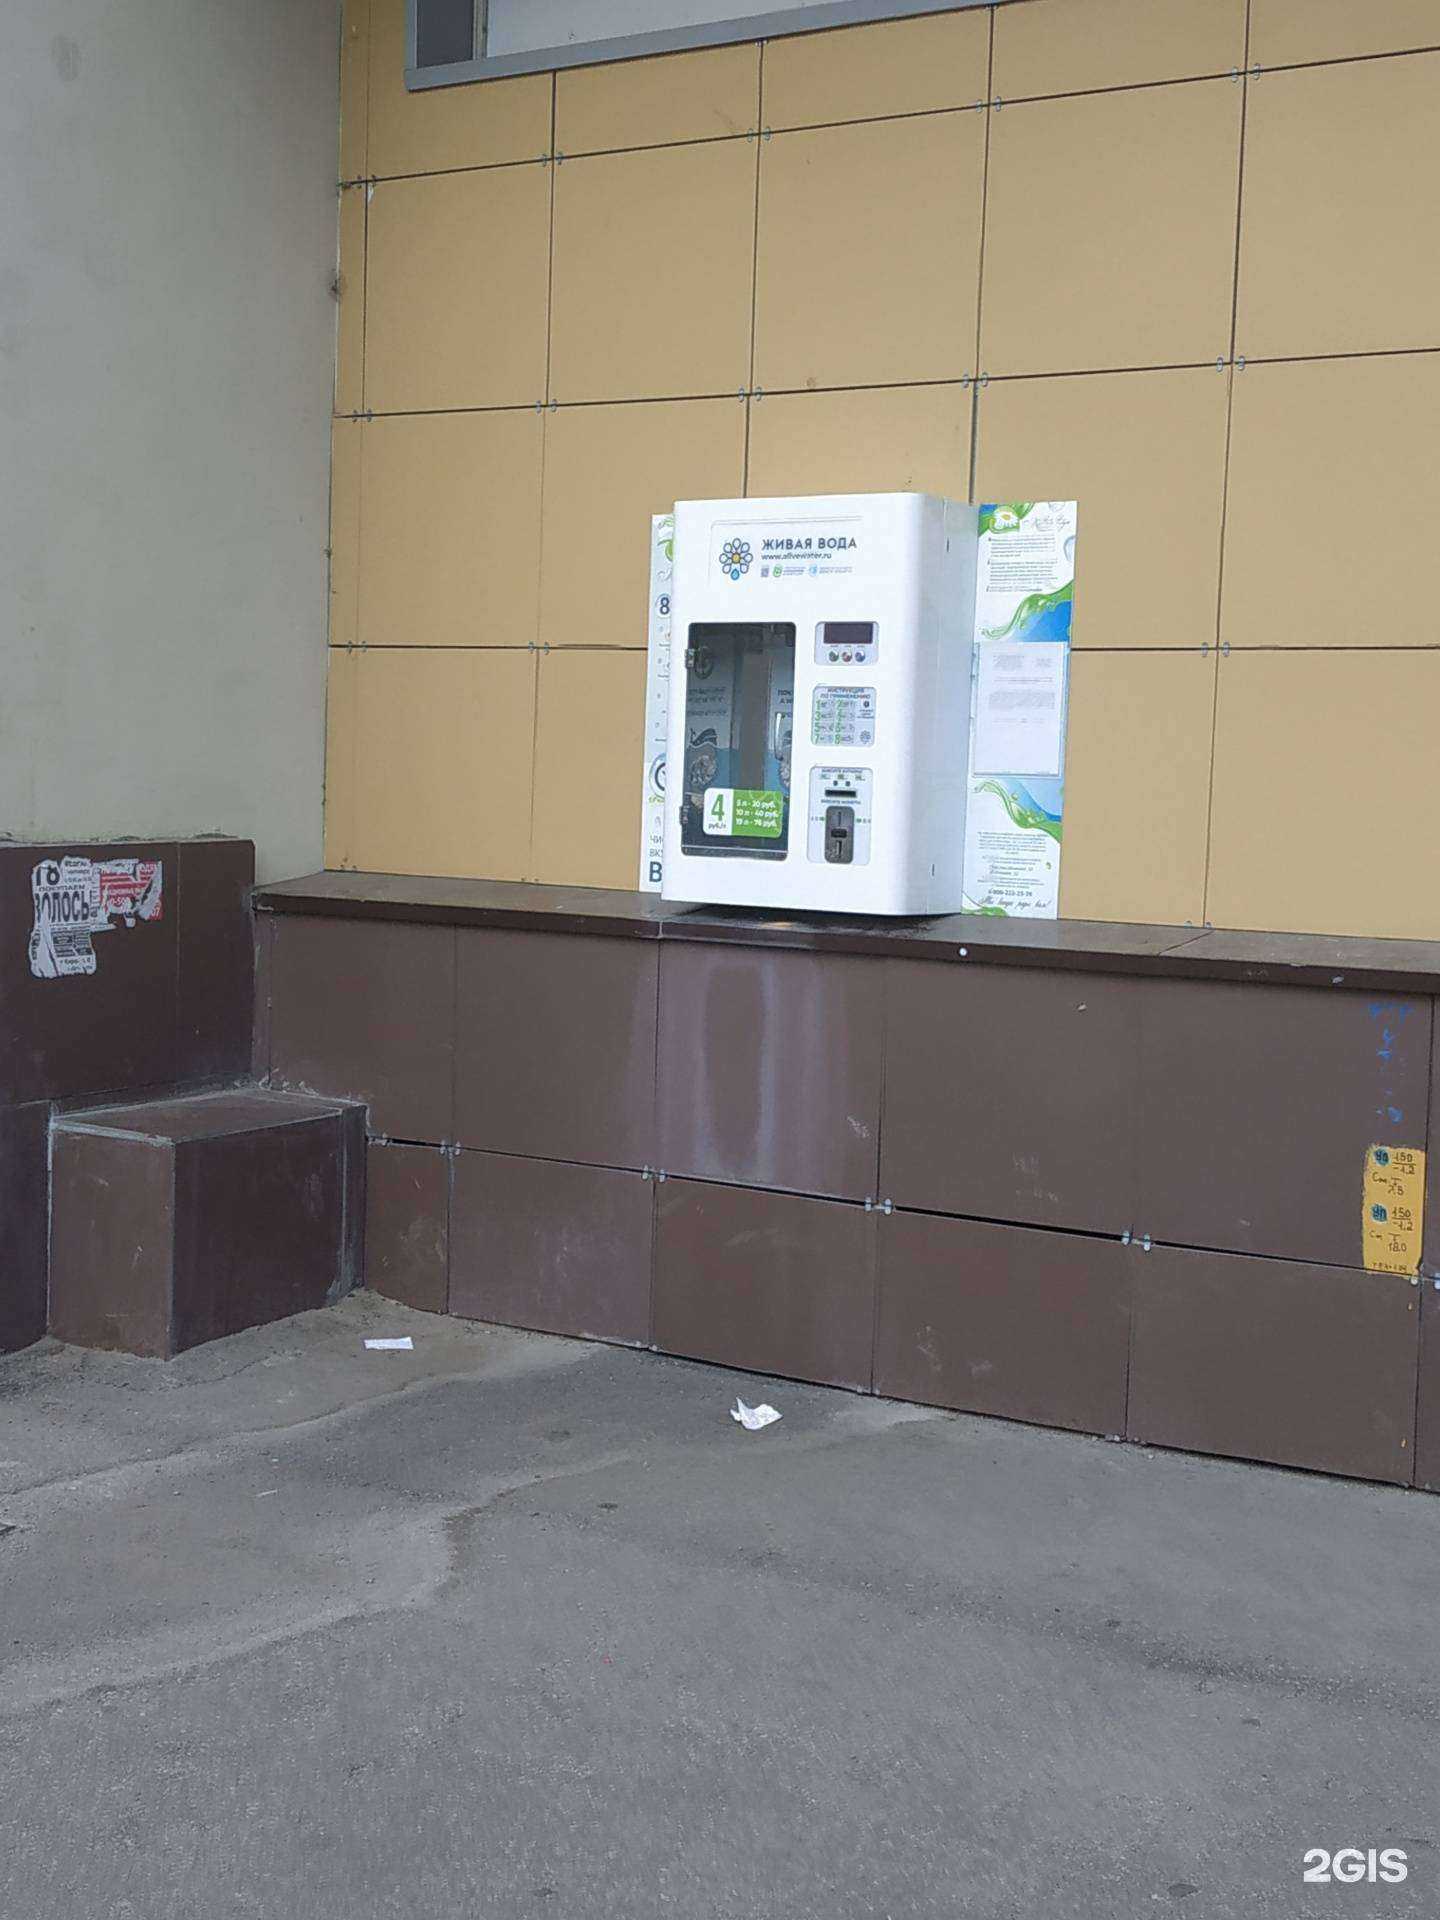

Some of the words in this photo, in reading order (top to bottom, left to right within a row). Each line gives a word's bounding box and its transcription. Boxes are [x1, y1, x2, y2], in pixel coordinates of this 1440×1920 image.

[762, 538, 812, 550] ЖИВАЯ
[818, 537, 857, 550] ВОДА
[660, 597, 670, 615] 8
[711, 794, 724, 821] 4
